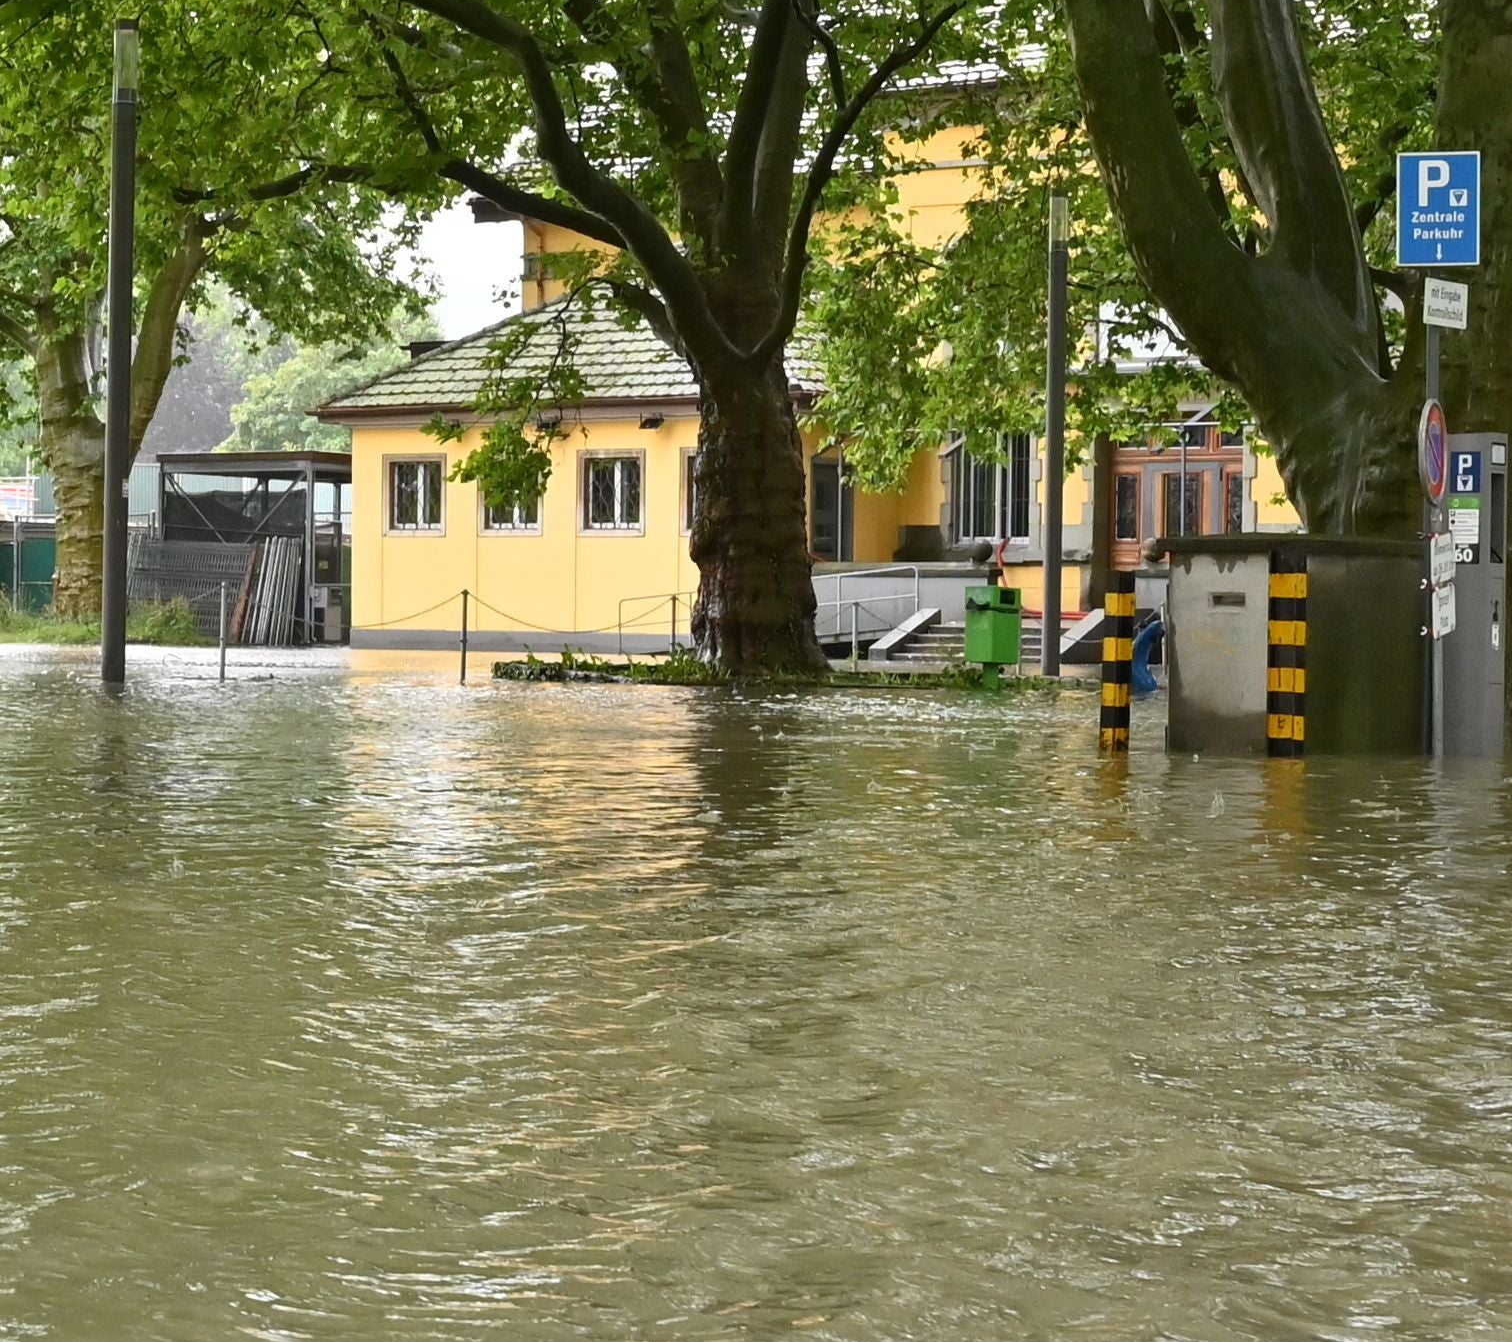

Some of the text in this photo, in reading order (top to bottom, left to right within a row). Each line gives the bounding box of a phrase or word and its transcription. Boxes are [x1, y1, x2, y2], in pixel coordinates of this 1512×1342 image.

[1418, 159, 1450, 207] P
[1411, 211, 1465, 223] Zentrale
[1413, 227, 1464, 240] Parkuhr
[1458, 454, 1473, 475] P
[1455, 548, 1473, 563] 60
